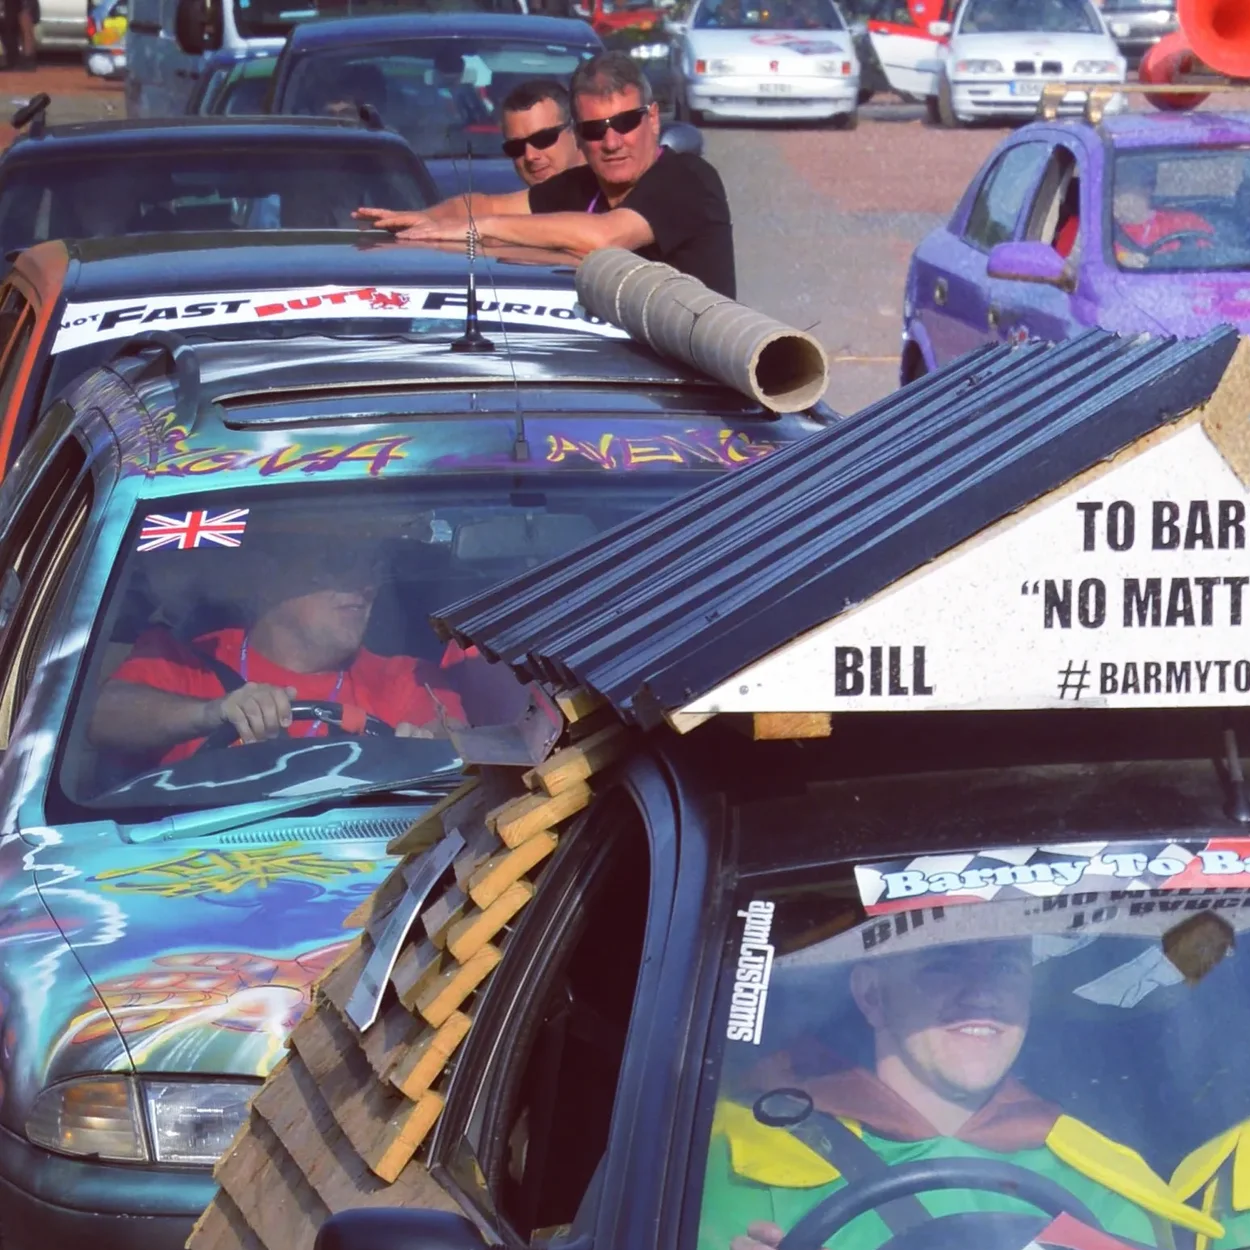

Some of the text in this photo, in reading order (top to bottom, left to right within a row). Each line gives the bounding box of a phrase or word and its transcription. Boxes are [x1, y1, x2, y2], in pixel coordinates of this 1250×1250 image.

[97, 299, 251, 332] FAST
[1076, 500, 1136, 552] TO
[834, 645, 934, 697] BILL
[879, 857, 1091, 900] Barmy
[1102, 850, 1188, 880] To
